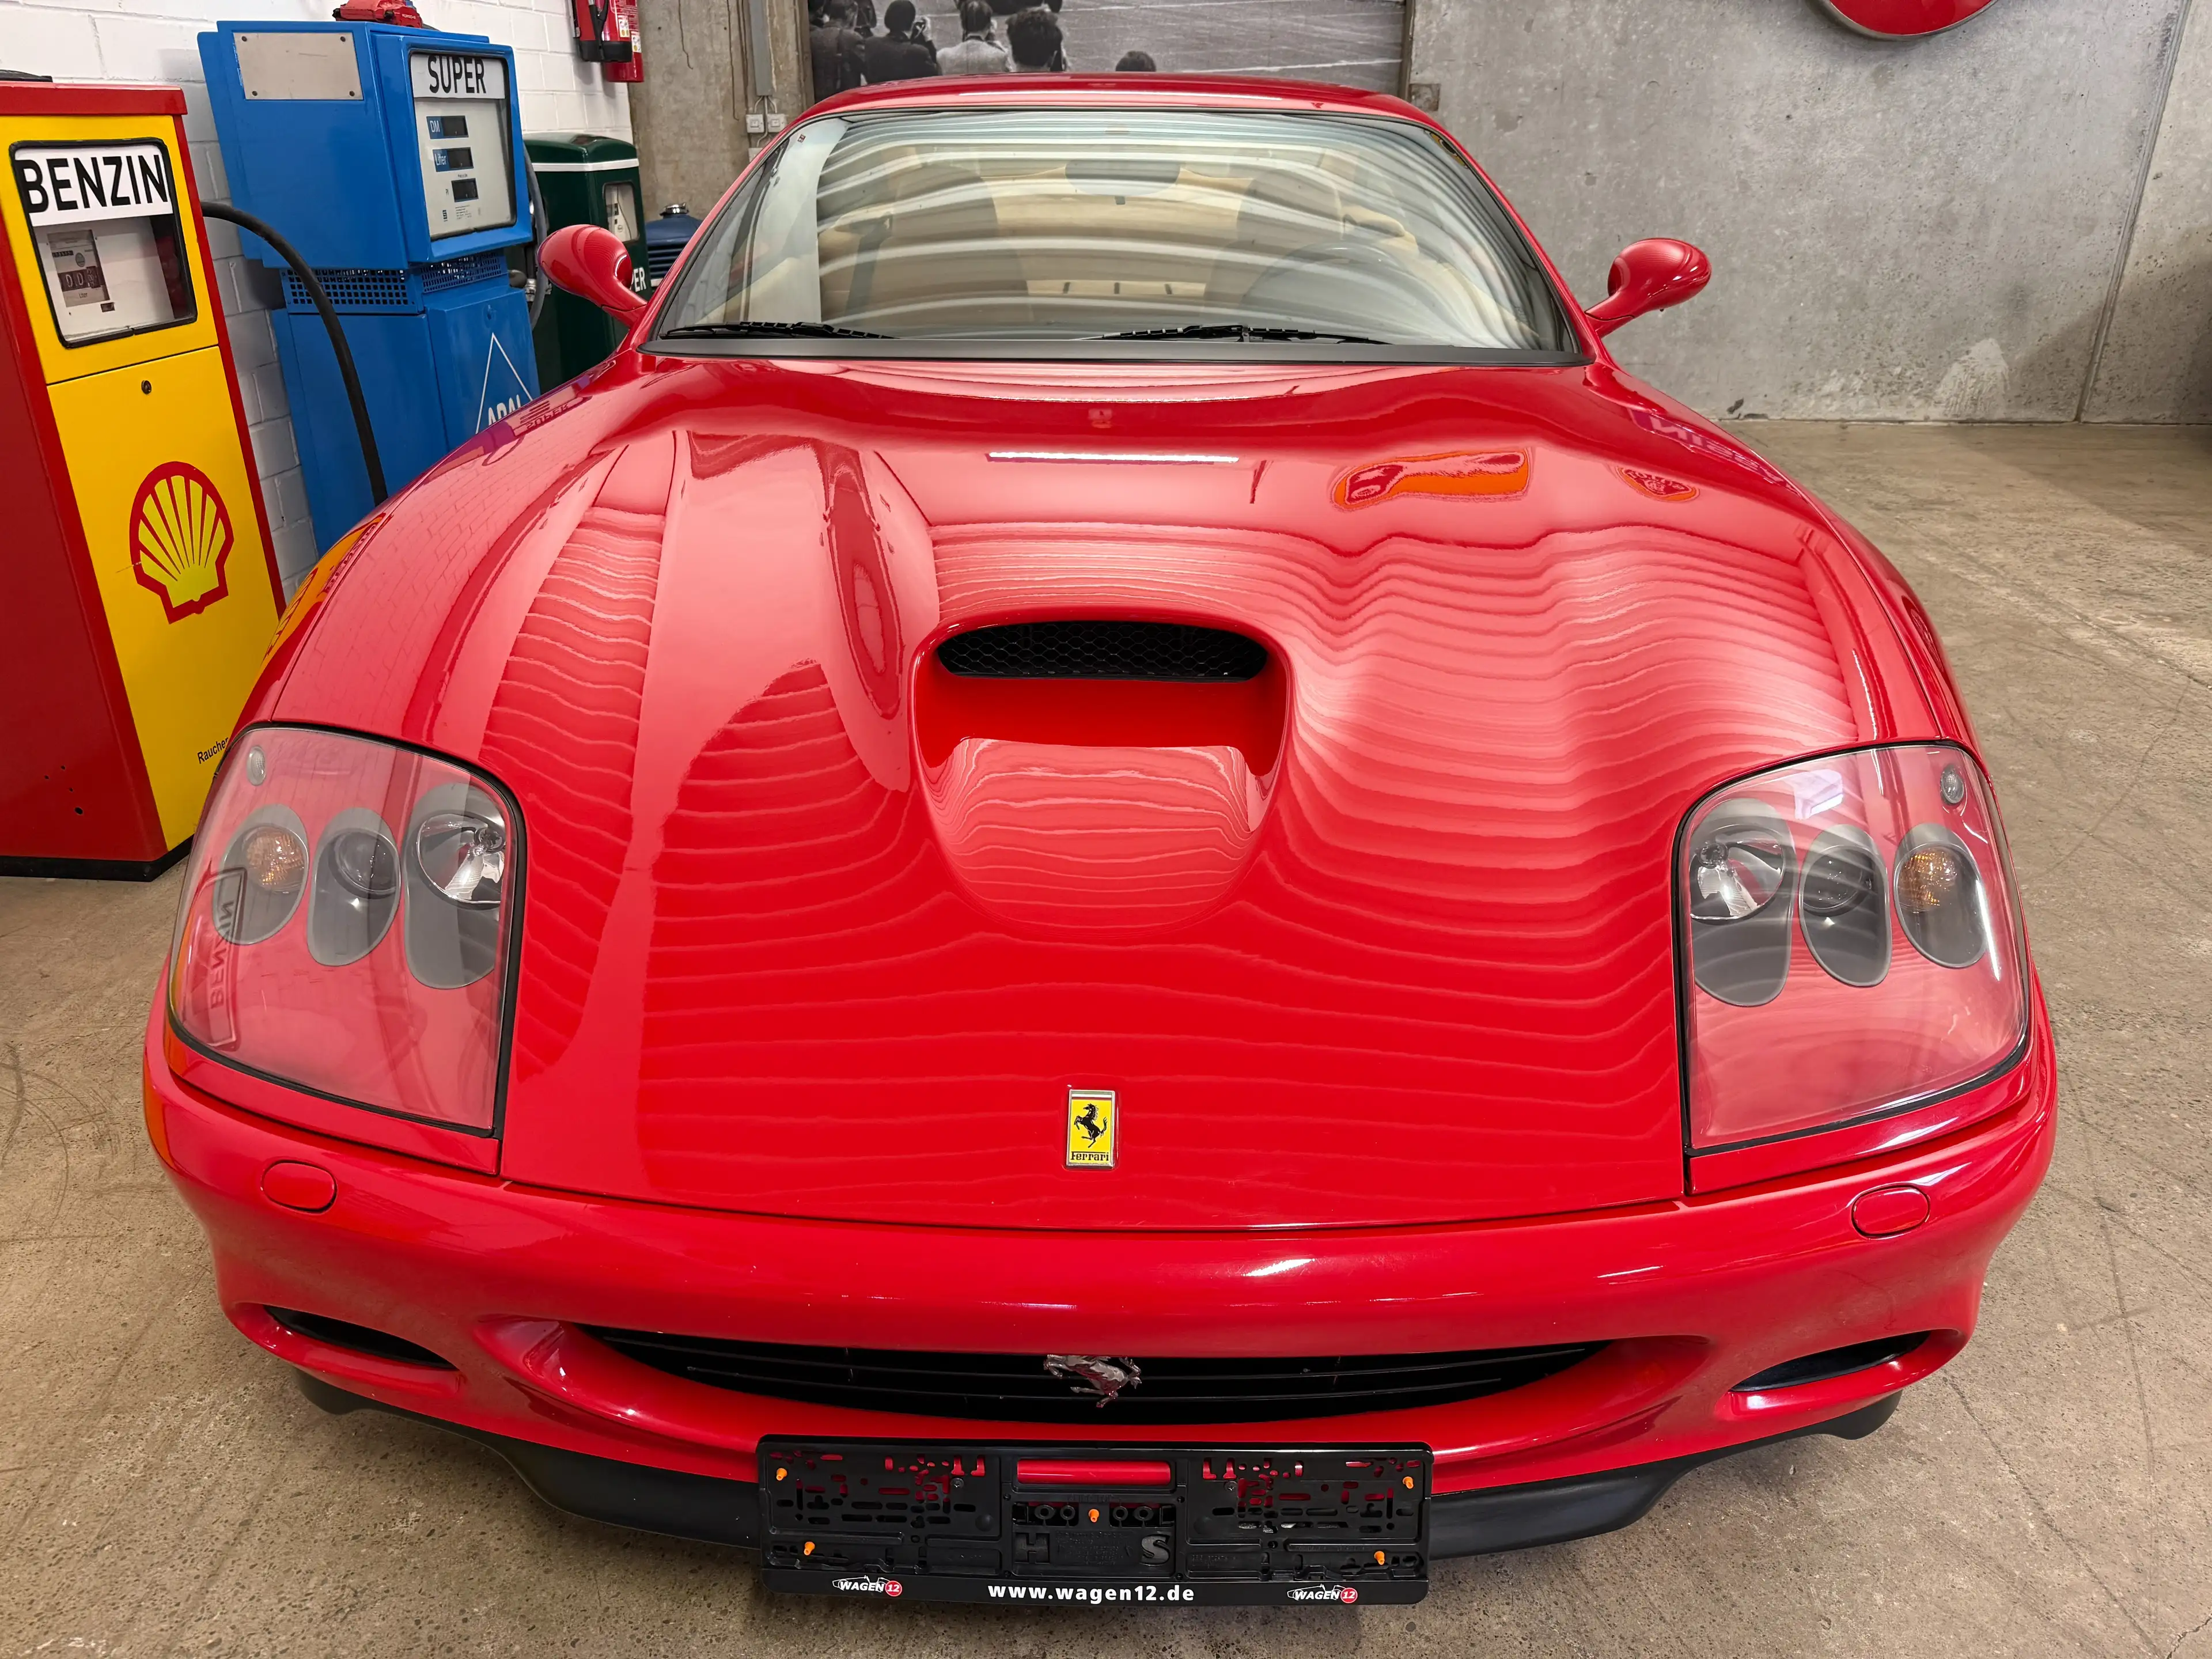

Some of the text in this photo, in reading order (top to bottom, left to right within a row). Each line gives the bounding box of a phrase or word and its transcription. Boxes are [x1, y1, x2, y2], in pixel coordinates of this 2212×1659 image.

[428, 55, 486, 93] SUPER
[430, 120, 440, 132] DM
[16, 154, 168, 214] BENZIN
[197, 737, 228, 764] Raucher
[1070, 1151, 1109, 1161] Ferrari
[988, 1585, 1195, 1604] www.wagen12.de
